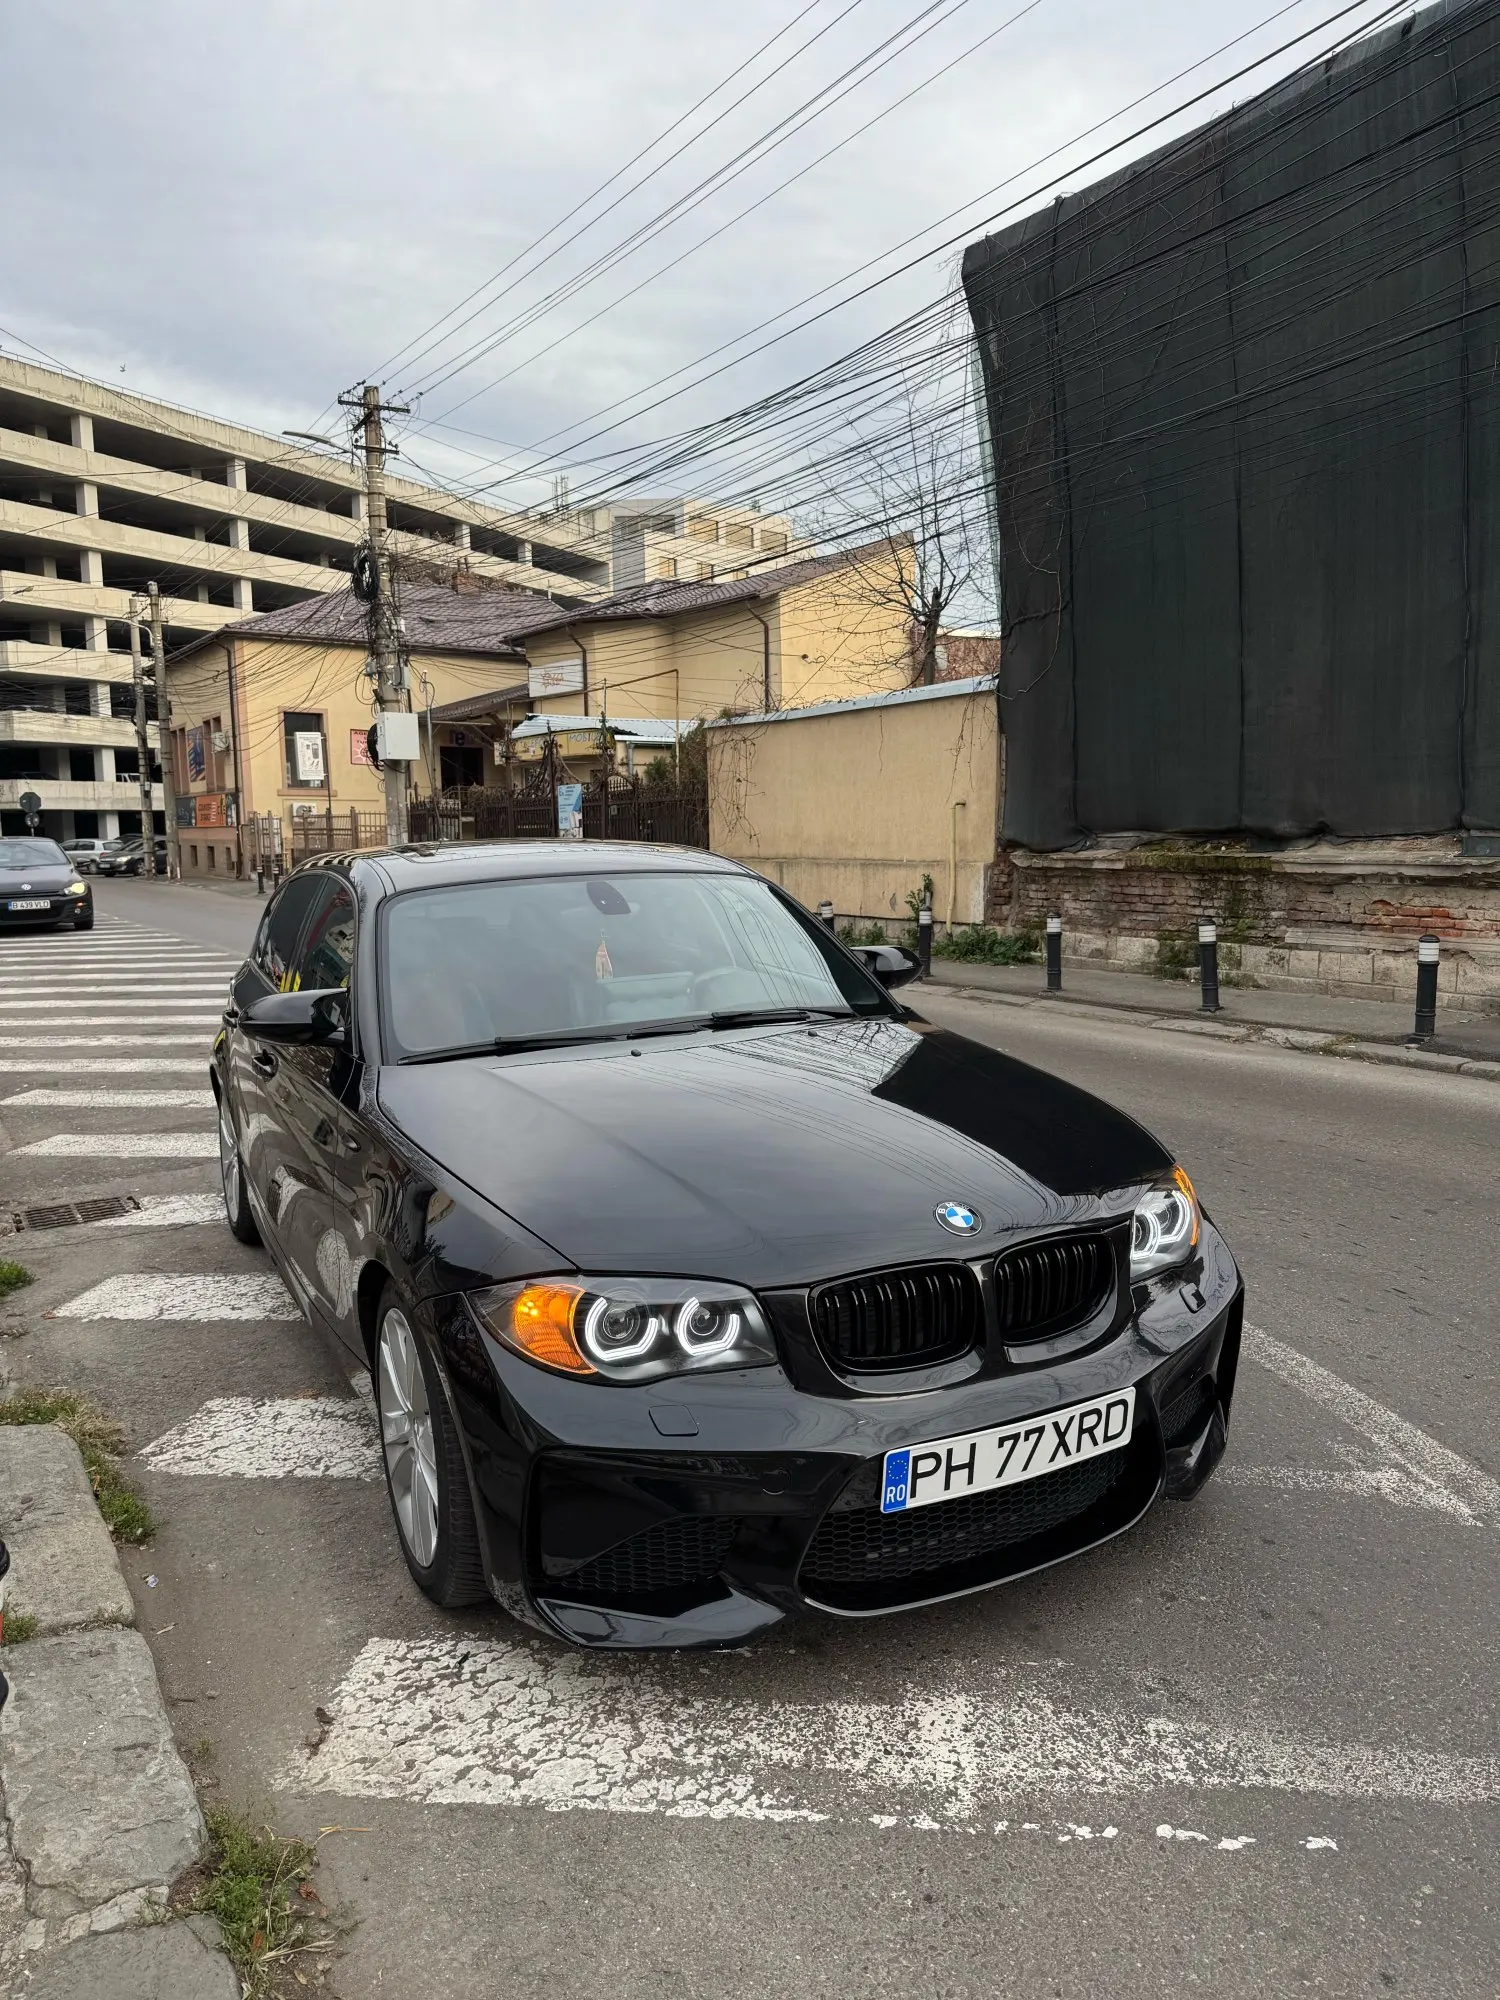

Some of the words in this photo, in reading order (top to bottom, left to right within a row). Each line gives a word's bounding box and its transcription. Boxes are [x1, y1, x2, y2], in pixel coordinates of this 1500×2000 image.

[20, 901, 33, 909] 439
[909, 1442, 977, 1499] PH
[886, 1484, 906, 1505] RO
